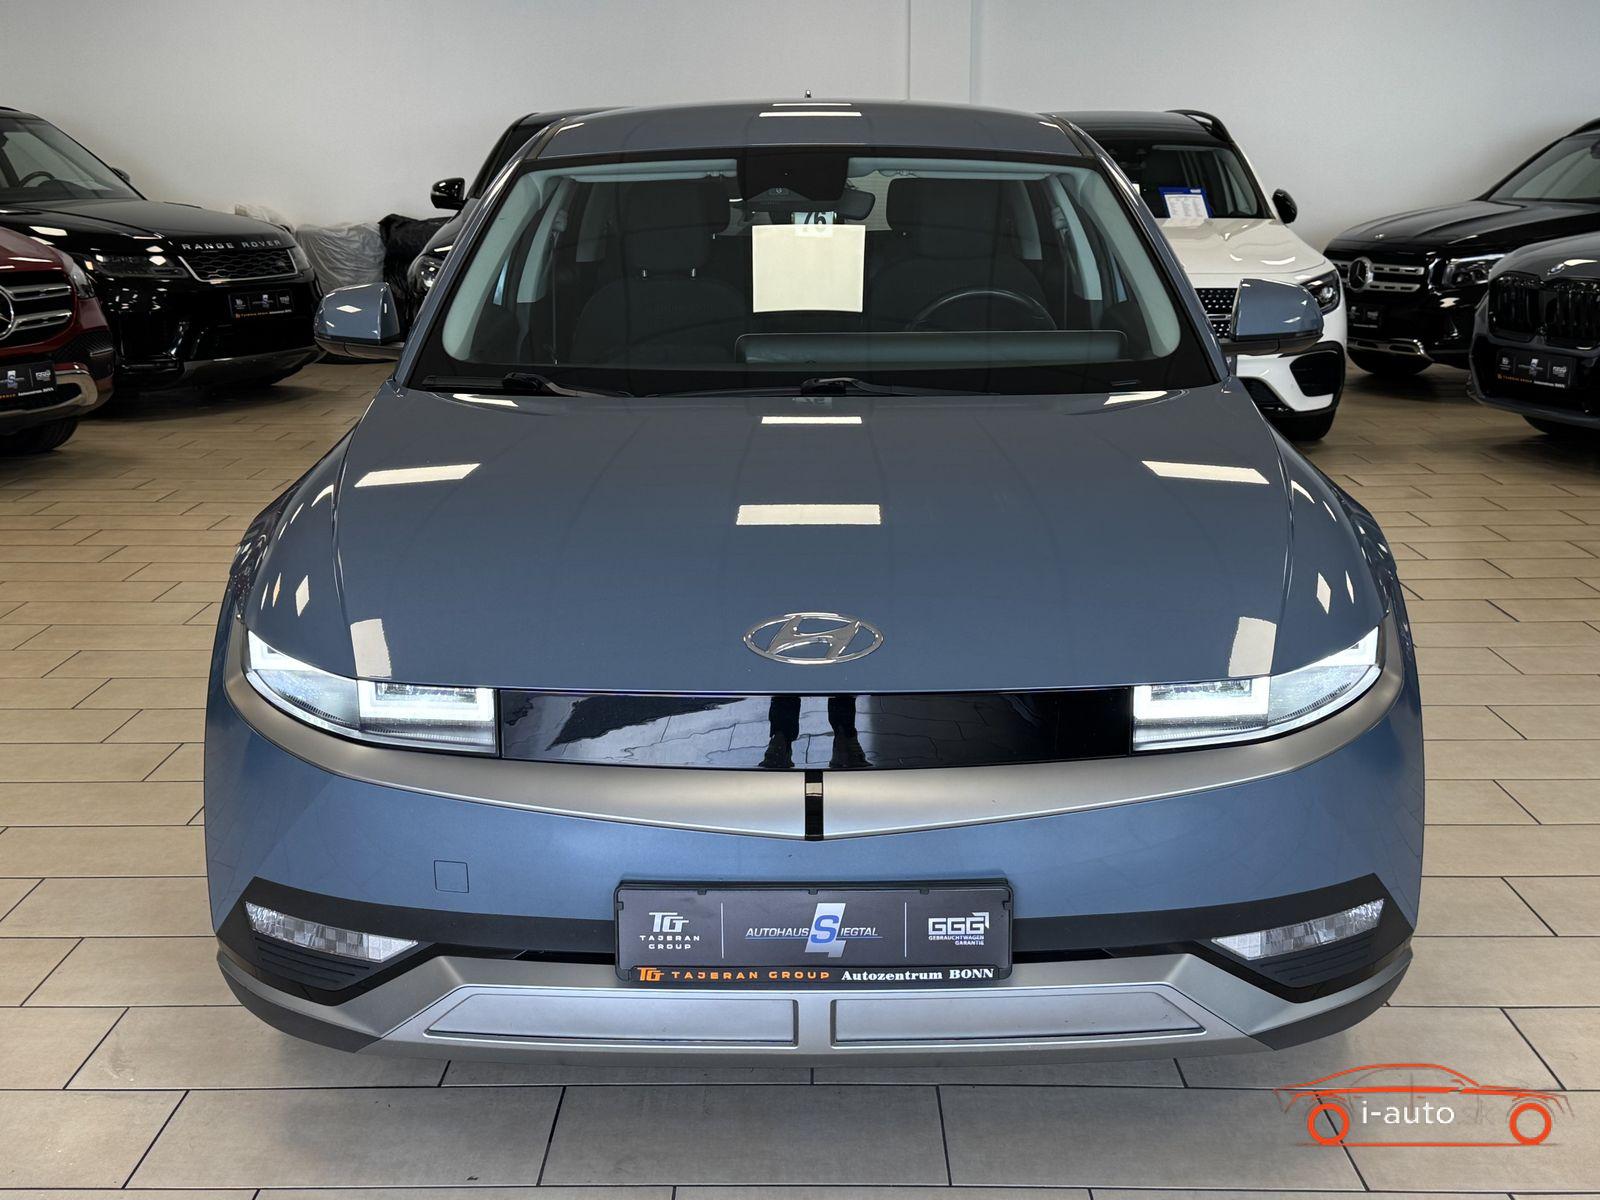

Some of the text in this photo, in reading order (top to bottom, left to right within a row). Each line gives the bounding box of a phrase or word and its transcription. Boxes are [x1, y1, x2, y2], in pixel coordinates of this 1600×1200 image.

[181, 239, 281, 250] RANGE ROVER
[928, 916, 987, 935] GGG
[745, 927, 810, 937] AUTOHAUS
[671, 971, 759, 980] TAJERAN
[768, 971, 830, 980] GROUP
[841, 970, 943, 981] Autozentrum
[949, 968, 994, 979] BONN
